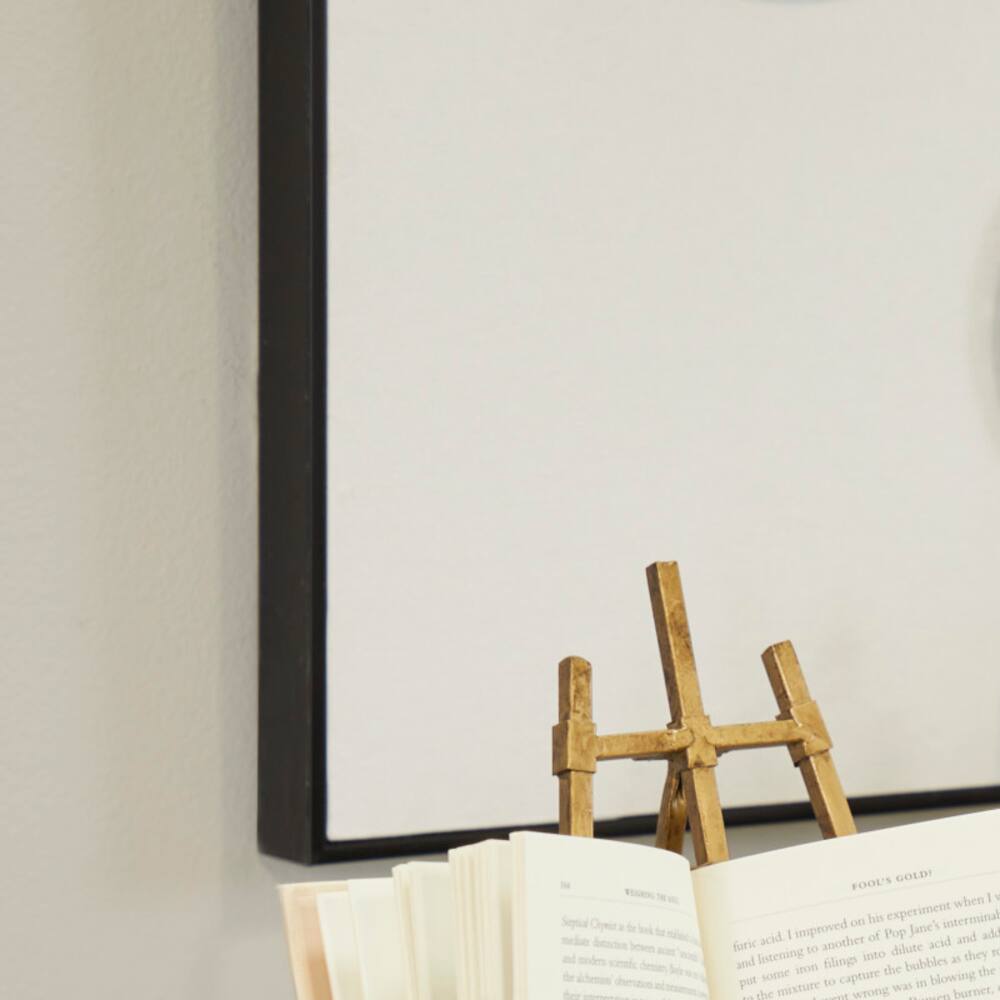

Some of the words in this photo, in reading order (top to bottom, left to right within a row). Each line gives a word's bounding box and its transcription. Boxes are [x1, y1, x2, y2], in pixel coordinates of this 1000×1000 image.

[851, 877, 892, 891] FOOL'S
[795, 917, 848, 939] improved
[886, 901, 951, 922] experiment
[757, 948, 804, 964] listening
[822, 935, 864, 951] another
[823, 956, 858, 969] filings
[891, 943, 923, 956] dilute
[777, 981, 820, 997] mixture
[839, 970, 880, 985] capture
[904, 956, 949, 972] bubbles
[852, 986, 890, 999] wrong
[929, 971, 976, 986] blowing
